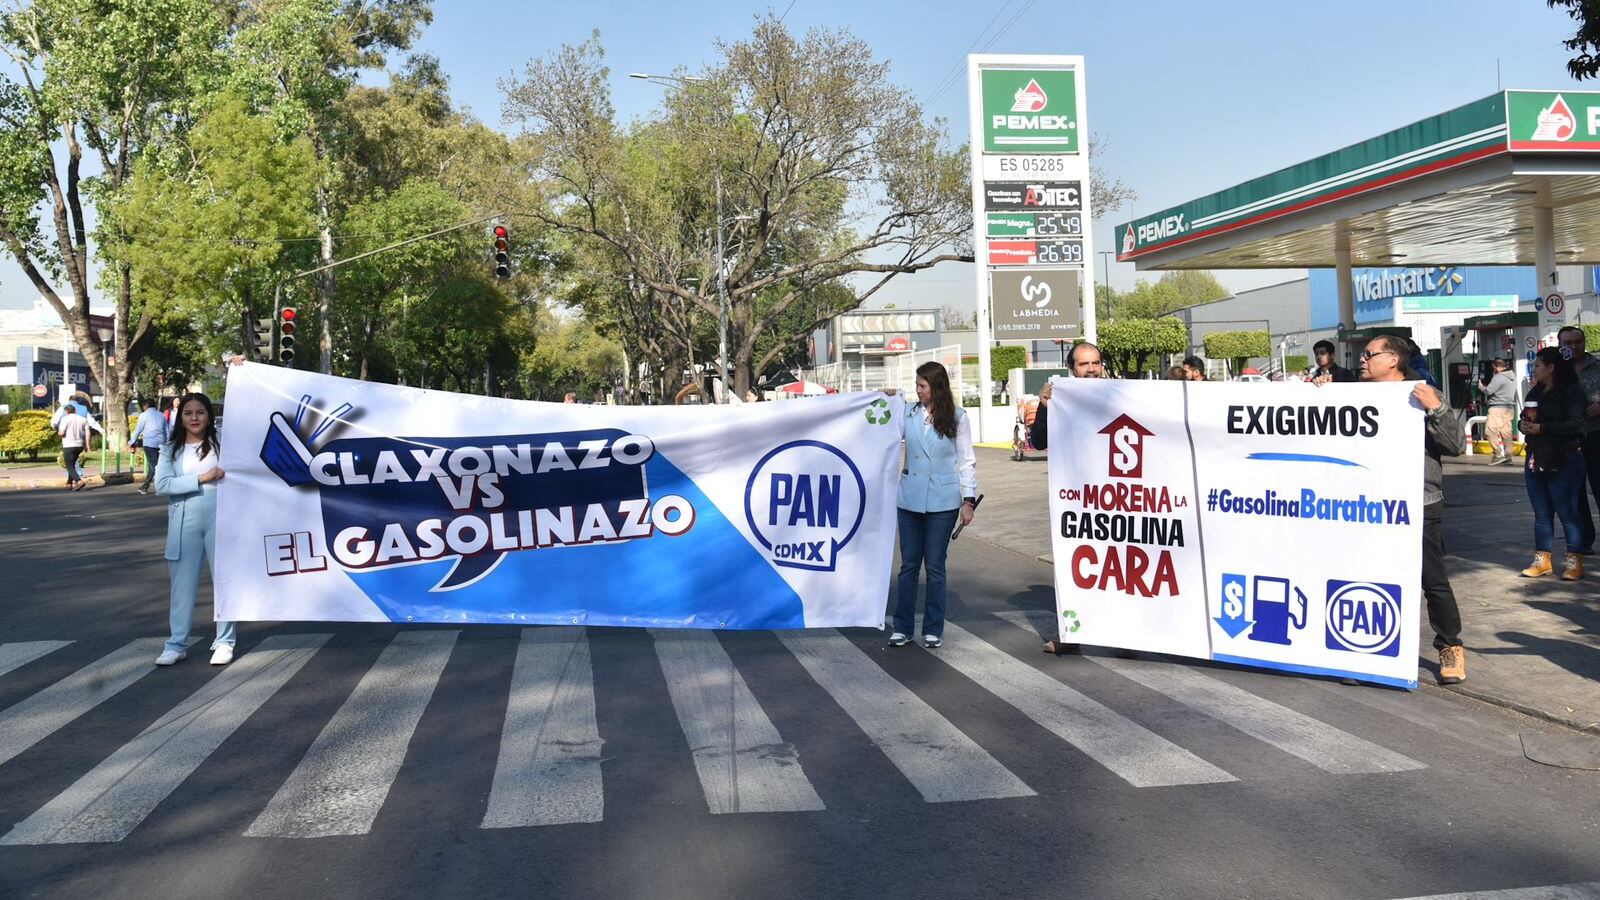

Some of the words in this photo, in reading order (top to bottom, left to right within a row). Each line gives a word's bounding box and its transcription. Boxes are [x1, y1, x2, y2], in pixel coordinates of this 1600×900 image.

[993, 115, 1068, 129] PEMEX
[1000, 158, 1017, 171] ES
[1022, 158, 1064, 171] 05285
[1007, 219, 1031, 228] Magna
[1038, 217, 1080, 234] 25.49
[1138, 213, 1184, 245] PEMEX
[1040, 245, 1081, 262] 26.99
[1354, 268, 1435, 302] Walmart
[1549, 272, 1556, 285] 1
[1013, 309, 1059, 317] LABMEDIA
[1550, 298, 1560, 308] 10
[1227, 405, 1379, 437] EXIGIMOS
[309, 434, 655, 486] CLAXONAZO
[437, 473, 505, 510] VS
[769, 473, 841, 528] PAN
[1059, 488, 1081, 501] CON
[1083, 482, 1173, 513] MORENA
[1174, 495, 1188, 507] LA
[1208, 488, 1410, 525] #GasolinaBarataYA
[263, 532, 328, 576] EL
[333, 494, 696, 568] GASOLINAZO
[1061, 511, 1185, 547] GASOLINA
[774, 540, 825, 563] CDMX
[1071, 544, 1180, 598] CARA
[1339, 599, 1387, 636] PAN
